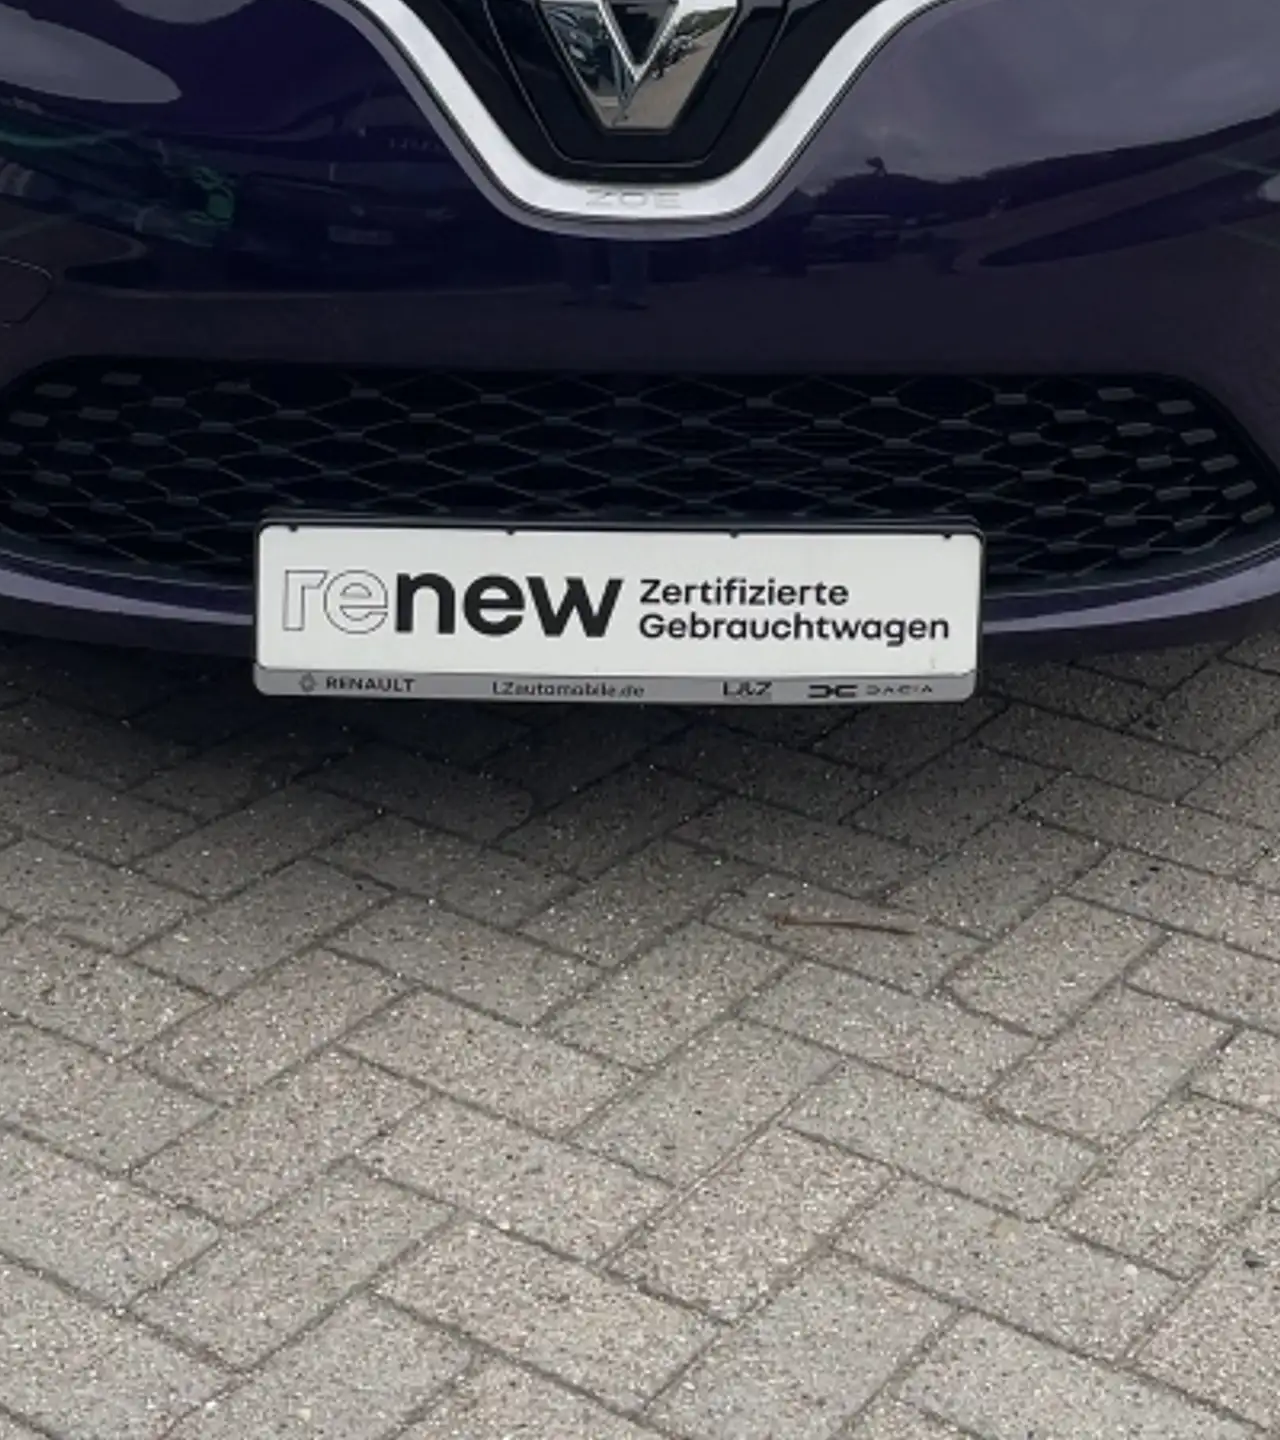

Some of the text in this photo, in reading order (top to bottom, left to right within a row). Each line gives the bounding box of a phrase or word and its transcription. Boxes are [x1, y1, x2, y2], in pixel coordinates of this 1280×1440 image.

[281, 568, 625, 639] renew
[638, 577, 850, 607] Zertifizierte
[638, 611, 950, 648] Gebrauchtwagen
[324, 675, 417, 694] RENAULT
